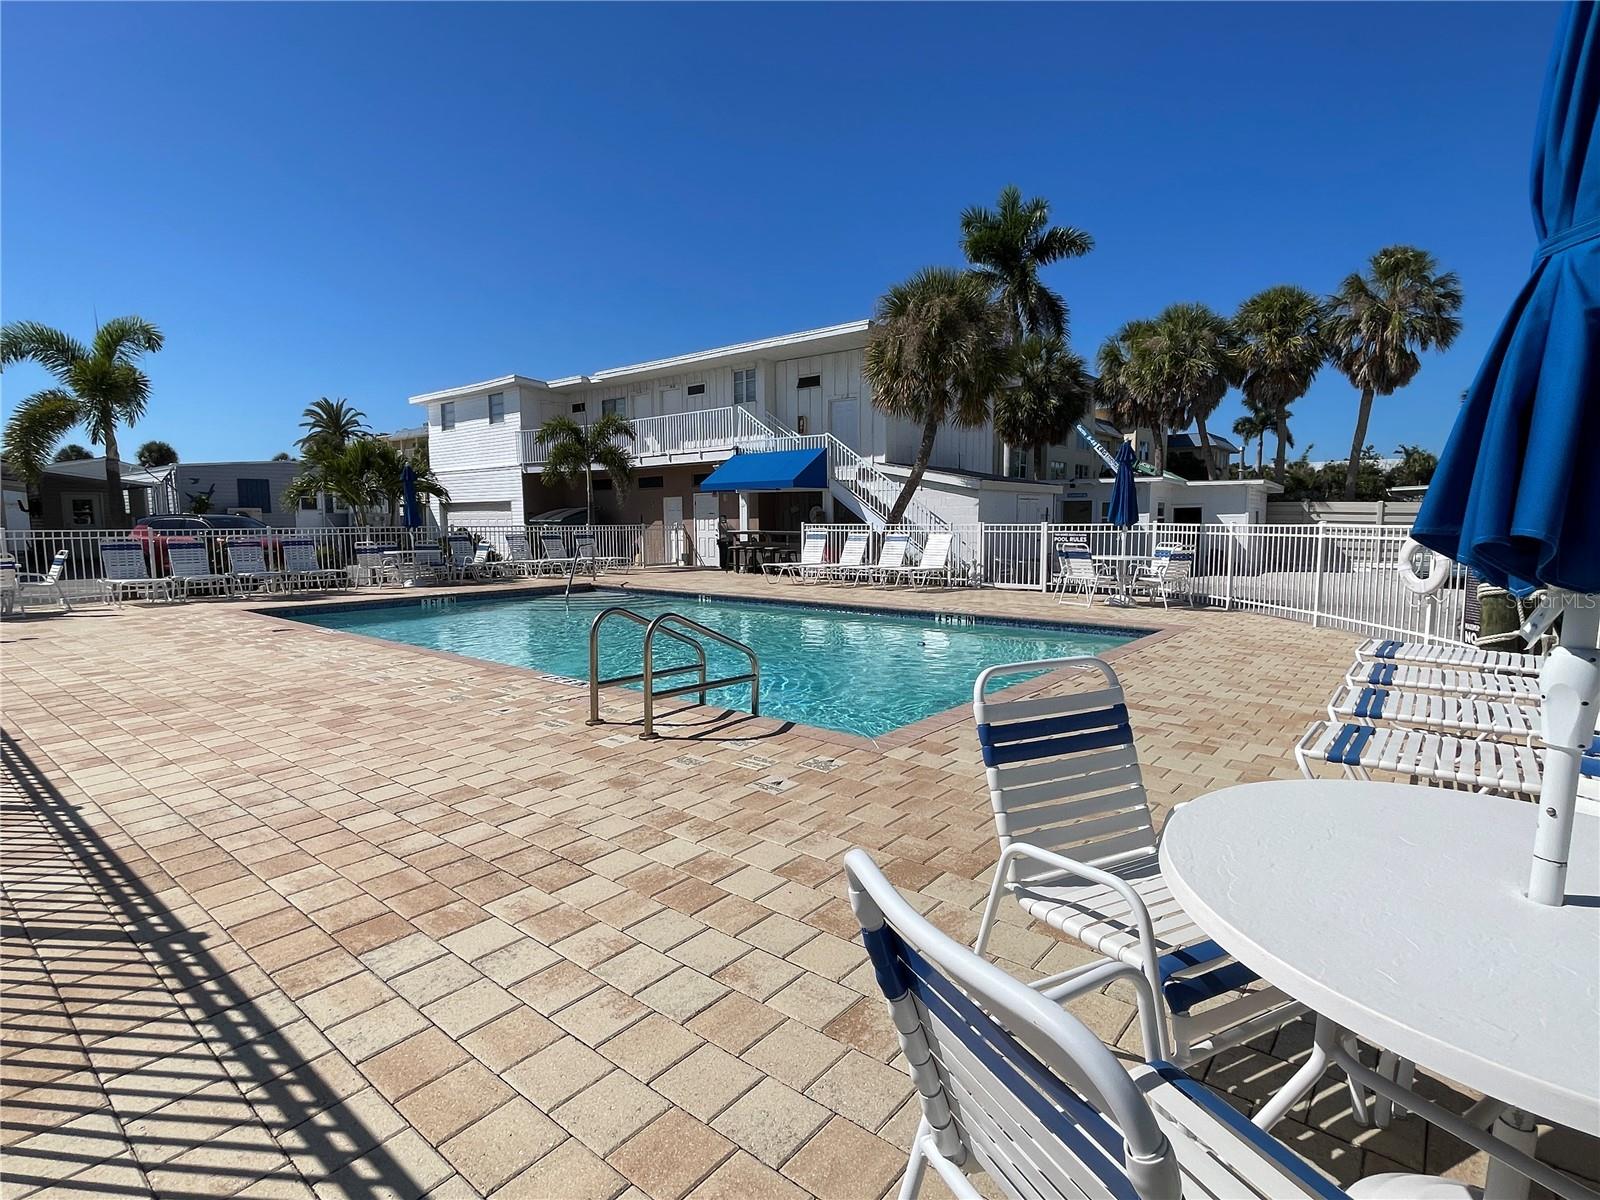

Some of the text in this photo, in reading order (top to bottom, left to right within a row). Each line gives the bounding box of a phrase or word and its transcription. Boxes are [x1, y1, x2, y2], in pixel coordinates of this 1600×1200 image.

[945, 614, 954, 625] FT
[965, 615, 974, 626] IN
[1464, 630, 1478, 644] NO
